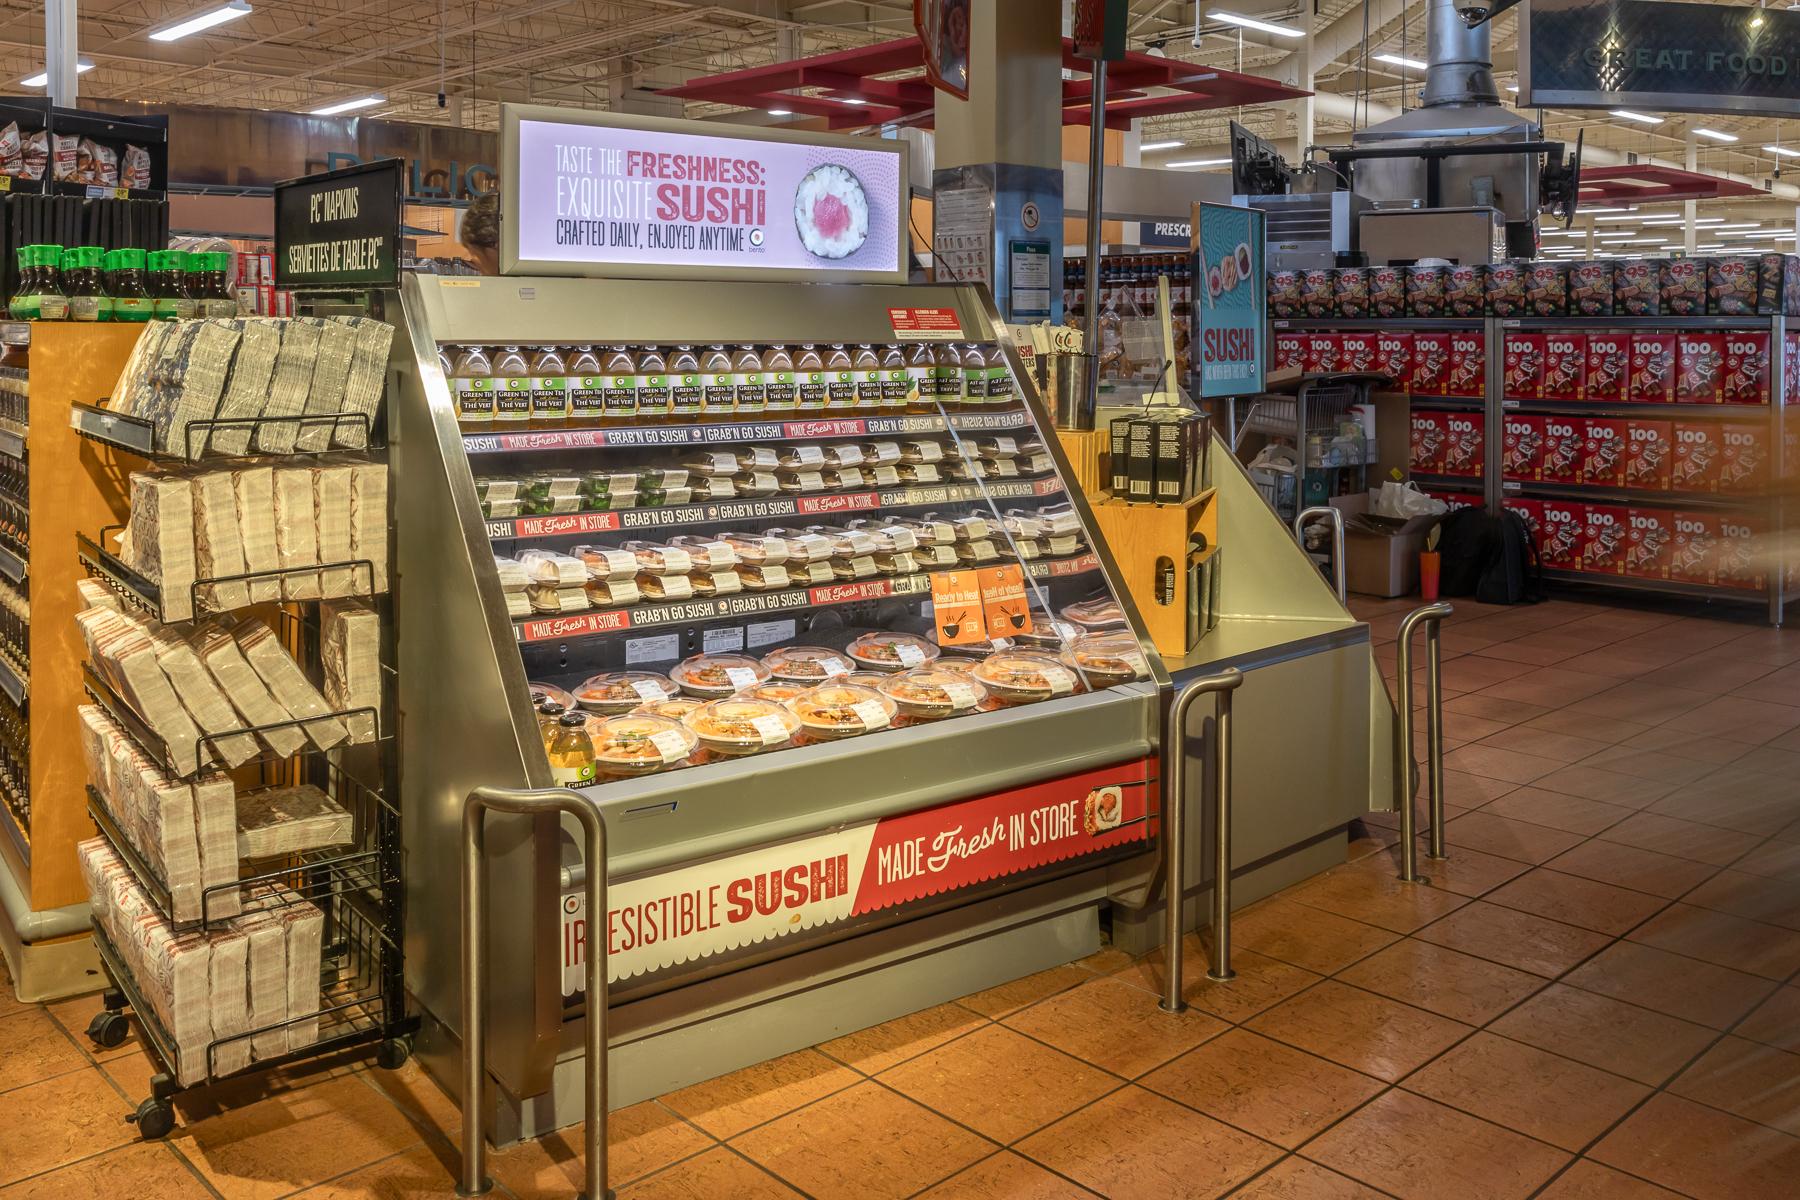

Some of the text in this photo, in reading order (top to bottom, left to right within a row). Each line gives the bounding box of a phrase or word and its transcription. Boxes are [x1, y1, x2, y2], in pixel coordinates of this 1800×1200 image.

[1706, 51, 1788, 76] FOOD
[555, 144, 766, 186] TASTE THE FRESHNESS:
[324, 187, 359, 222] NAPKINS
[557, 175, 766, 226] EXQUISITE SUSHI
[556, 218, 744, 252] CRAFTED DAILY, ENJOYED ANYTIME
[1154, 222, 1192, 238] PRESCR
[289, 243, 330, 274] SERVIETTES
[330, 241, 341, 272] DE
[342, 239, 367, 271] TABLE
[1204, 328, 1255, 362] SUSHI
[1277, 340, 1299, 350] 100
[1310, 340, 1332, 350] 100
[1343, 340, 1365, 350] 100
[1378, 340, 1401, 351] 100
[1415, 341, 1438, 351] 100
[1453, 341, 1476, 352] 100
[1506, 342, 1533, 352] 100
[1547, 342, 1574, 353] 100
[1590, 342, 1617, 354] 100
[1633, 342, 1663, 354] 100
[1680, 342, 1712, 354] 100
[1726, 342, 1757, 354] 100
[789, 421, 859, 437] MADE Fresh IN STORE
[868, 418, 933, 432] GRAB'N GO SUSHI
[1412, 419, 1435, 430] 100
[1448, 421, 1472, 432] 100
[1505, 423, 1532, 434] 100
[1546, 425, 1573, 436] 100
[608, 429, 688, 444] GRAB'N GO SUSHI
[707, 425, 781, 441] GRAB'N GO SUSHI
[1586, 427, 1614, 438] 100
[1629, 429, 1658, 441] 100
[1676, 431, 1706, 443] 100
[464, 436, 497, 451] SUSHI
[509, 432, 597, 448] MADE Fresh IN STORE
[912, 490, 924, 502] GO
[925, 489, 947, 501] SUSHI
[721, 500, 795, 519] GRAB'N GO SUSHI
[803, 494, 874, 512] MADE Fresh IN STORE
[623, 508, 704, 527] GRAB'N GO SUSHI
[1544, 511, 1571, 522] 100
[1586, 513, 1614, 525] 100
[1629, 517, 1658, 529] 100
[524, 515, 611, 535] MADE Fresh IN STORE
[1675, 520, 1706, 533] 100
[926, 575, 931, 589] G
[815, 582, 887, 602] MADE Fresh IN STORE
[935, 590, 979, 604] Ready to Heat
[732, 592, 807, 612] GRAB'N GO SUSHI
[634, 603, 715, 624] GRAB'N GO SUSHI
[532, 622, 552, 637] MADE
[553, 617, 587, 635] Fresh
[589, 616, 598, 630] IN
[598, 614, 622, 629] STORE
[878, 799, 1080, 886] MADE Fresh IN STORE
[565, 853, 849, 968] IRESISTIBLE SUSHI
